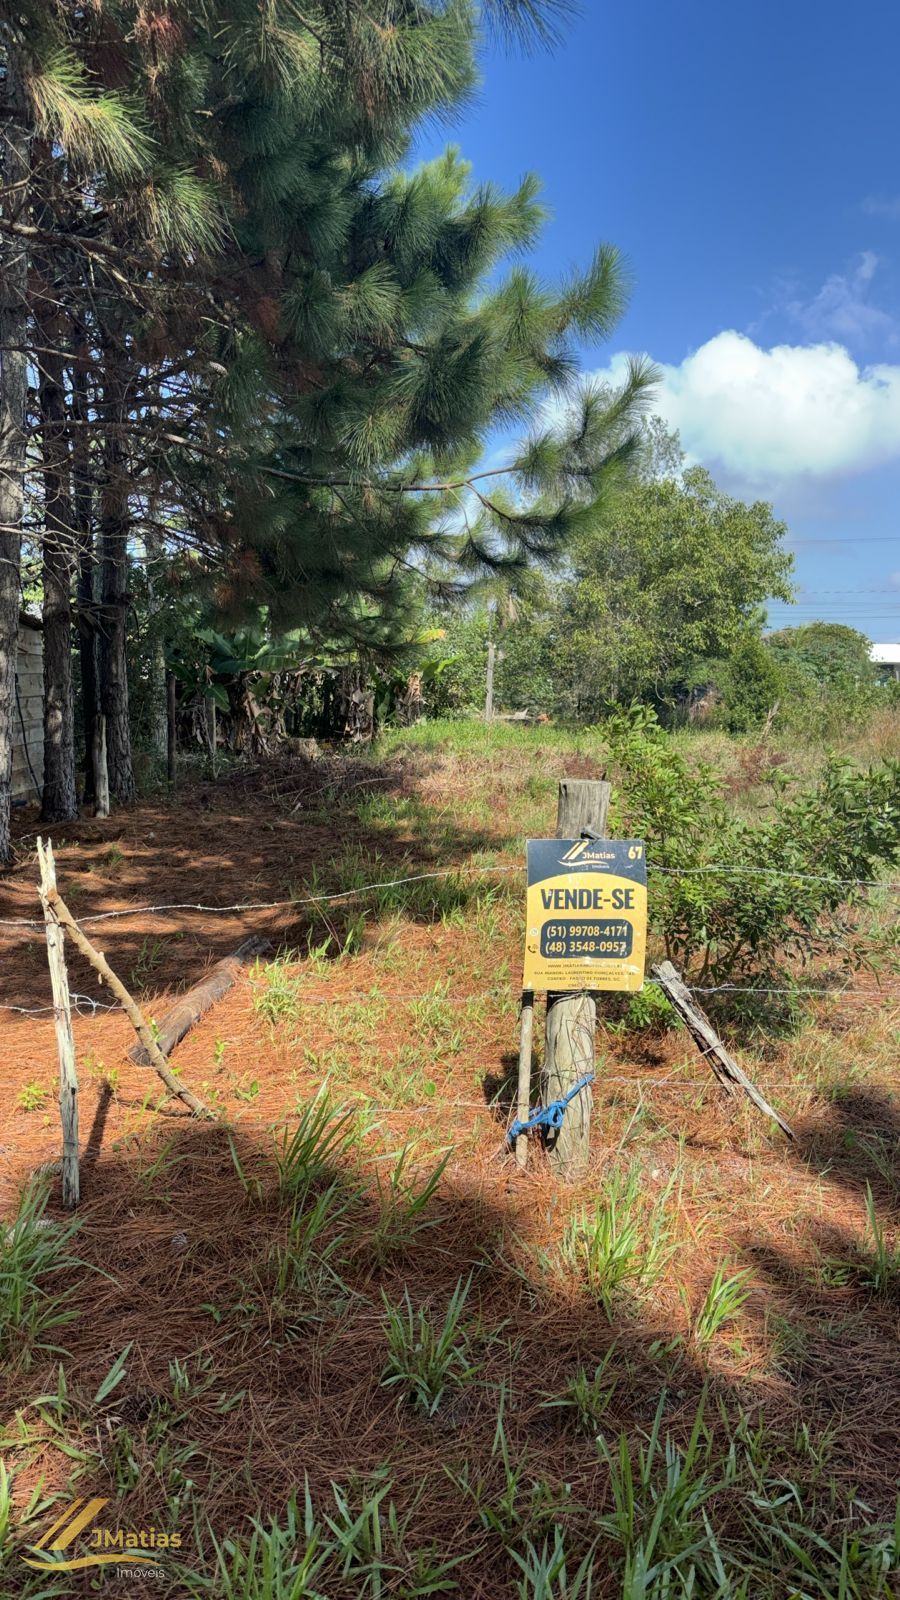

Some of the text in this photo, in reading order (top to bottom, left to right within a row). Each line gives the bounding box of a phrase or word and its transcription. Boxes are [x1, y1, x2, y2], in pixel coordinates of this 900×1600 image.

[582, 851, 616, 860] JMatias
[628, 846, 643, 860] 67
[540, 888, 635, 910] VENDE-SE
[546, 925, 628, 939] (51) 99708-4171
[545, 941, 627, 955] (48) 3548-0957
